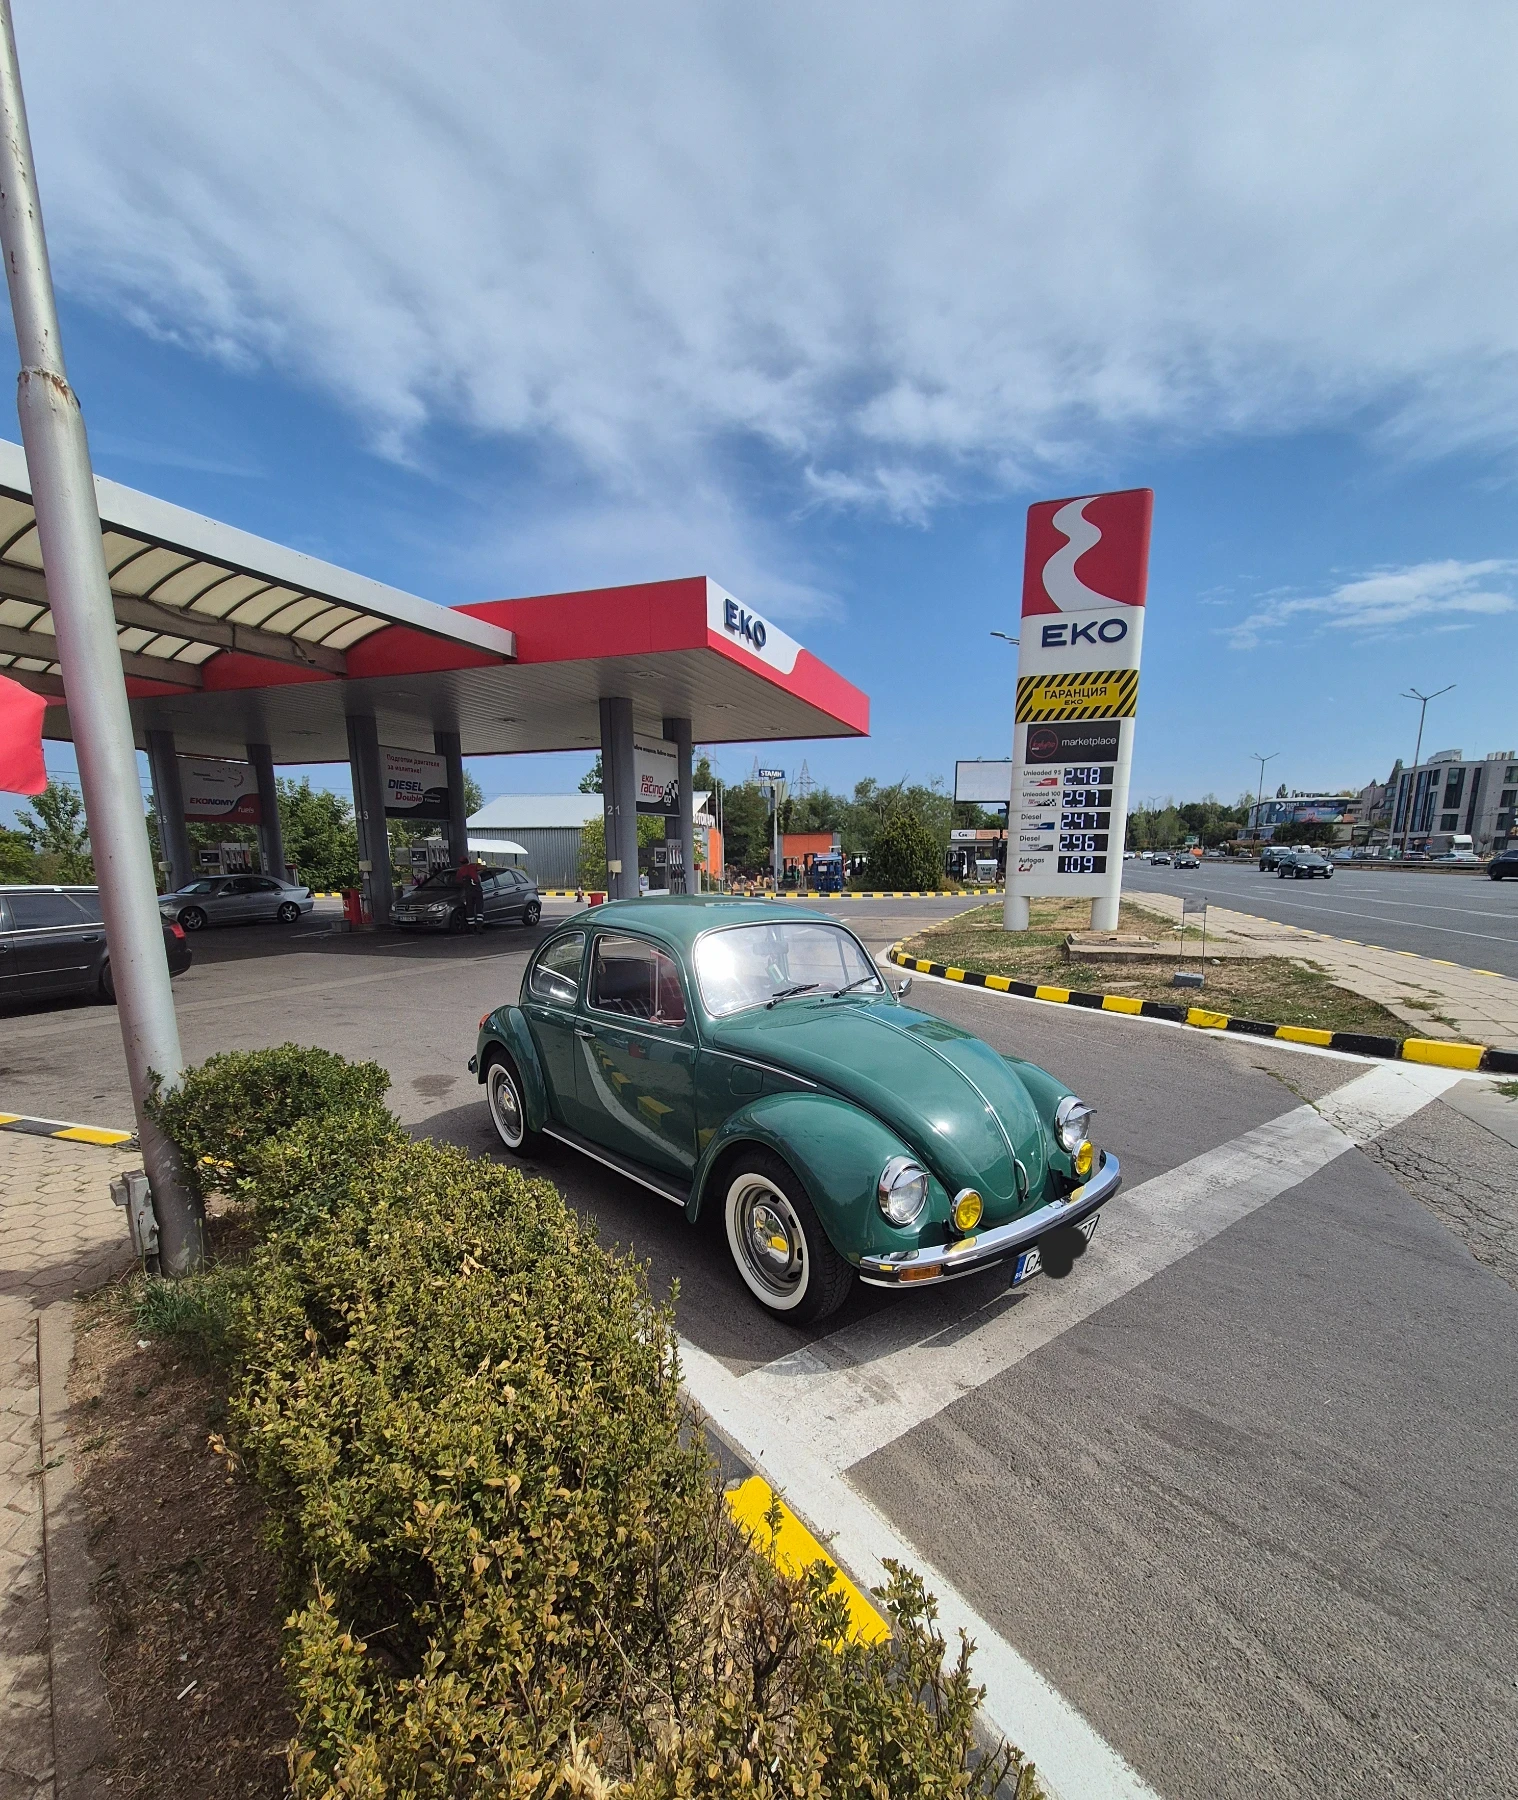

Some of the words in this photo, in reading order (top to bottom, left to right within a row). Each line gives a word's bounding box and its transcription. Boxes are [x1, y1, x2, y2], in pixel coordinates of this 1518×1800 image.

[724, 598, 767, 648] EKO
[1041, 618, 1128, 648] EKO
[1044, 686, 1107, 700] ГАРАНЦИЯ
[1061, 736, 1117, 747] marketplace
[1064, 767, 1100, 785] 2.48
[388, 779, 424, 792] DIESEL
[640, 783, 664, 798] racing
[189, 797, 234, 806] EKONOMY
[395, 791, 423, 803] Double
[1062, 790, 1099, 807] 2.97
[1061, 812, 1097, 830] 2.47
[1059, 834, 1095, 851] 2.96
[1064, 856, 1094, 873] 1.09
